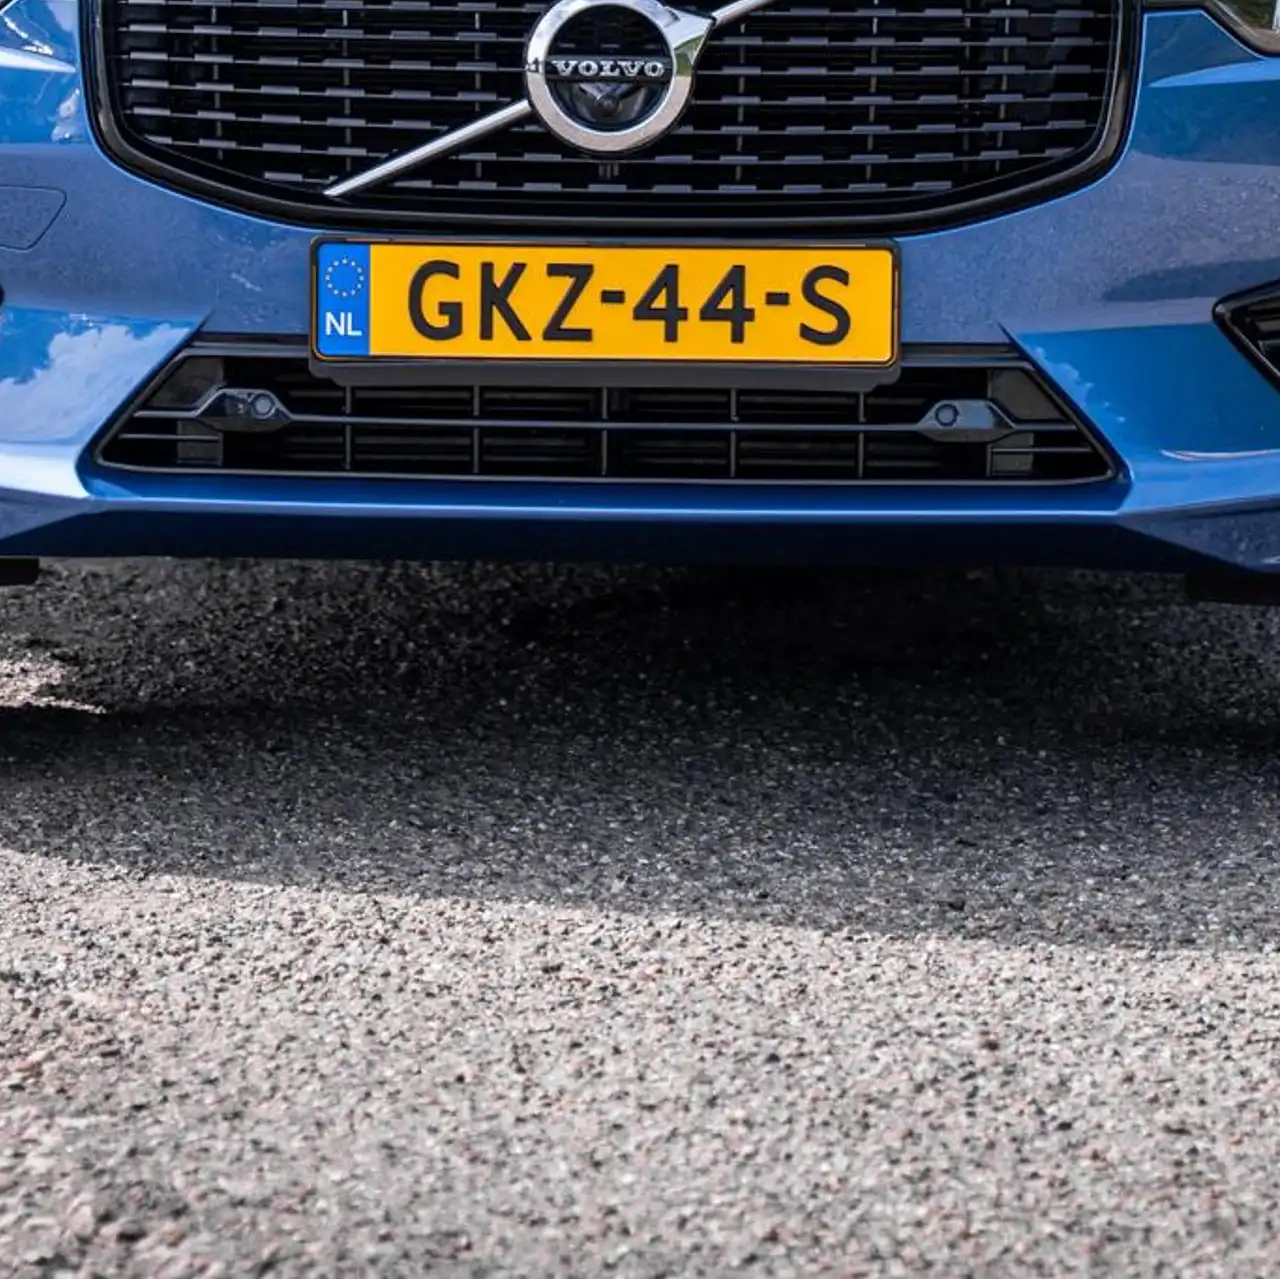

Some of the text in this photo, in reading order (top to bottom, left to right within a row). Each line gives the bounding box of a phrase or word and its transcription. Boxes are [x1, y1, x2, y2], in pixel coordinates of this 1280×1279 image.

[551, 59, 665, 77] VOLVO
[325, 259, 852, 346] NL GKZ-44-S
